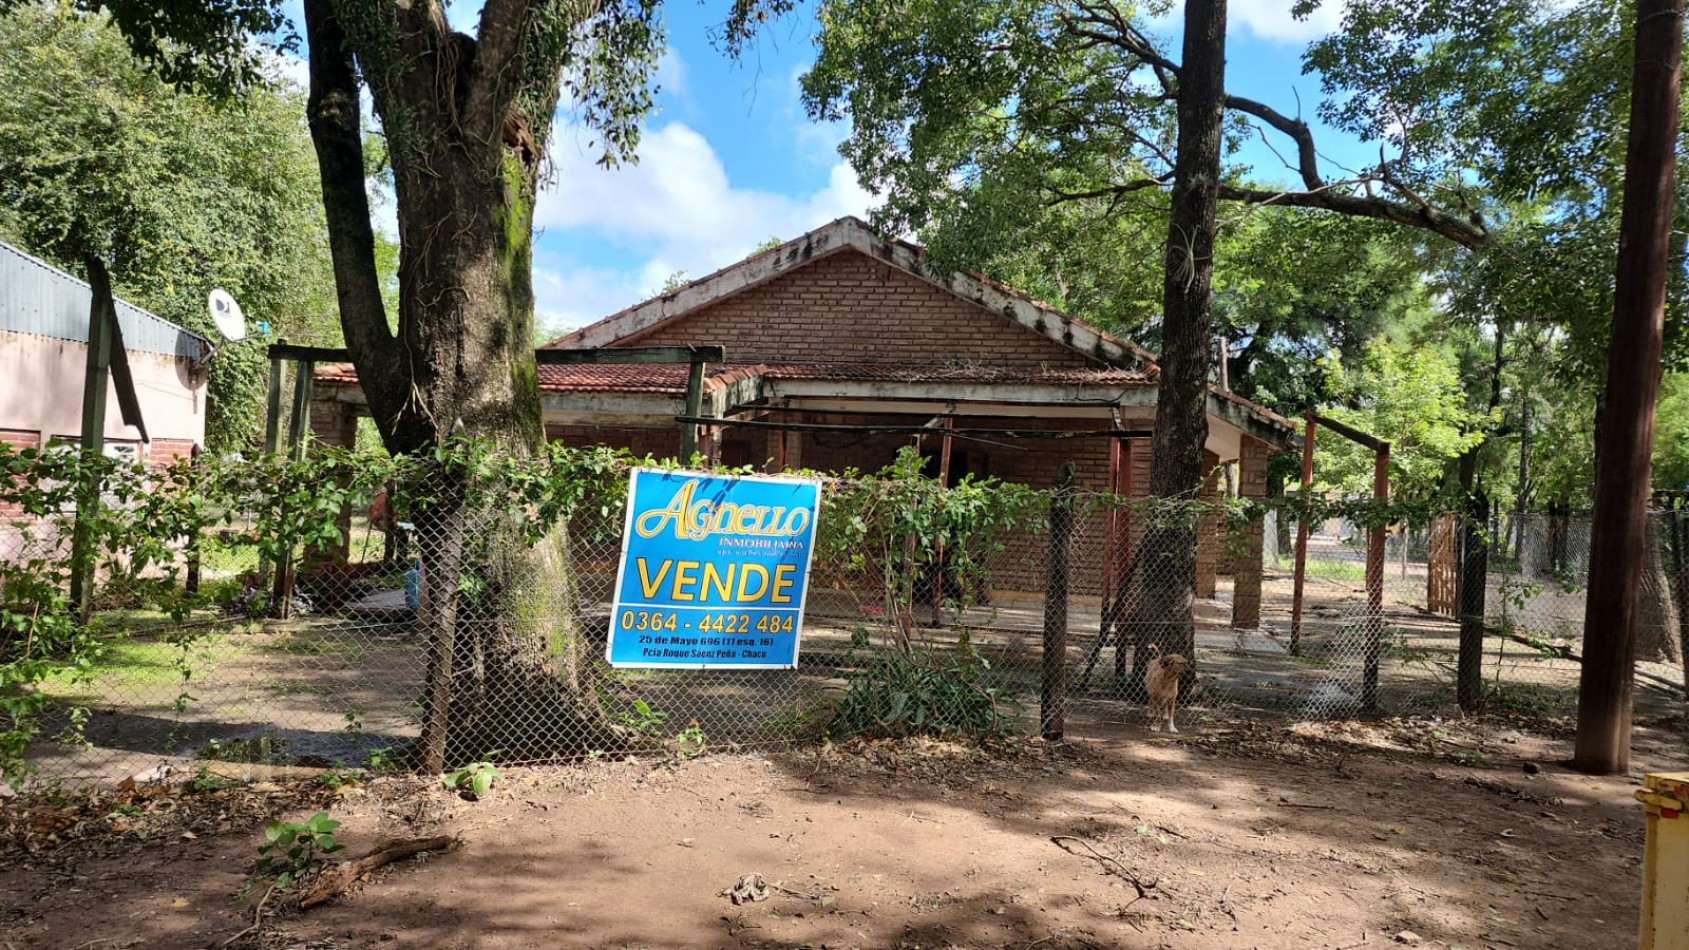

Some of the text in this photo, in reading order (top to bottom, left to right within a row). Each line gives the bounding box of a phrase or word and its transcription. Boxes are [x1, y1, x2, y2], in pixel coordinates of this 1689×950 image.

[636, 557, 797, 603] VENDE
[620, 610, 677, 631] 0364
[698, 614, 750, 633] 4422
[756, 614, 794, 634] 484
[639, 635, 652, 644] 25
[654, 636, 668, 645] de
[670, 636, 698, 646] Mayo
[700, 637, 720, 646] 696
[663, 648, 690, 658] Roque
[716, 649, 736, 658] Peña
[742, 650, 767, 659] Chaco
